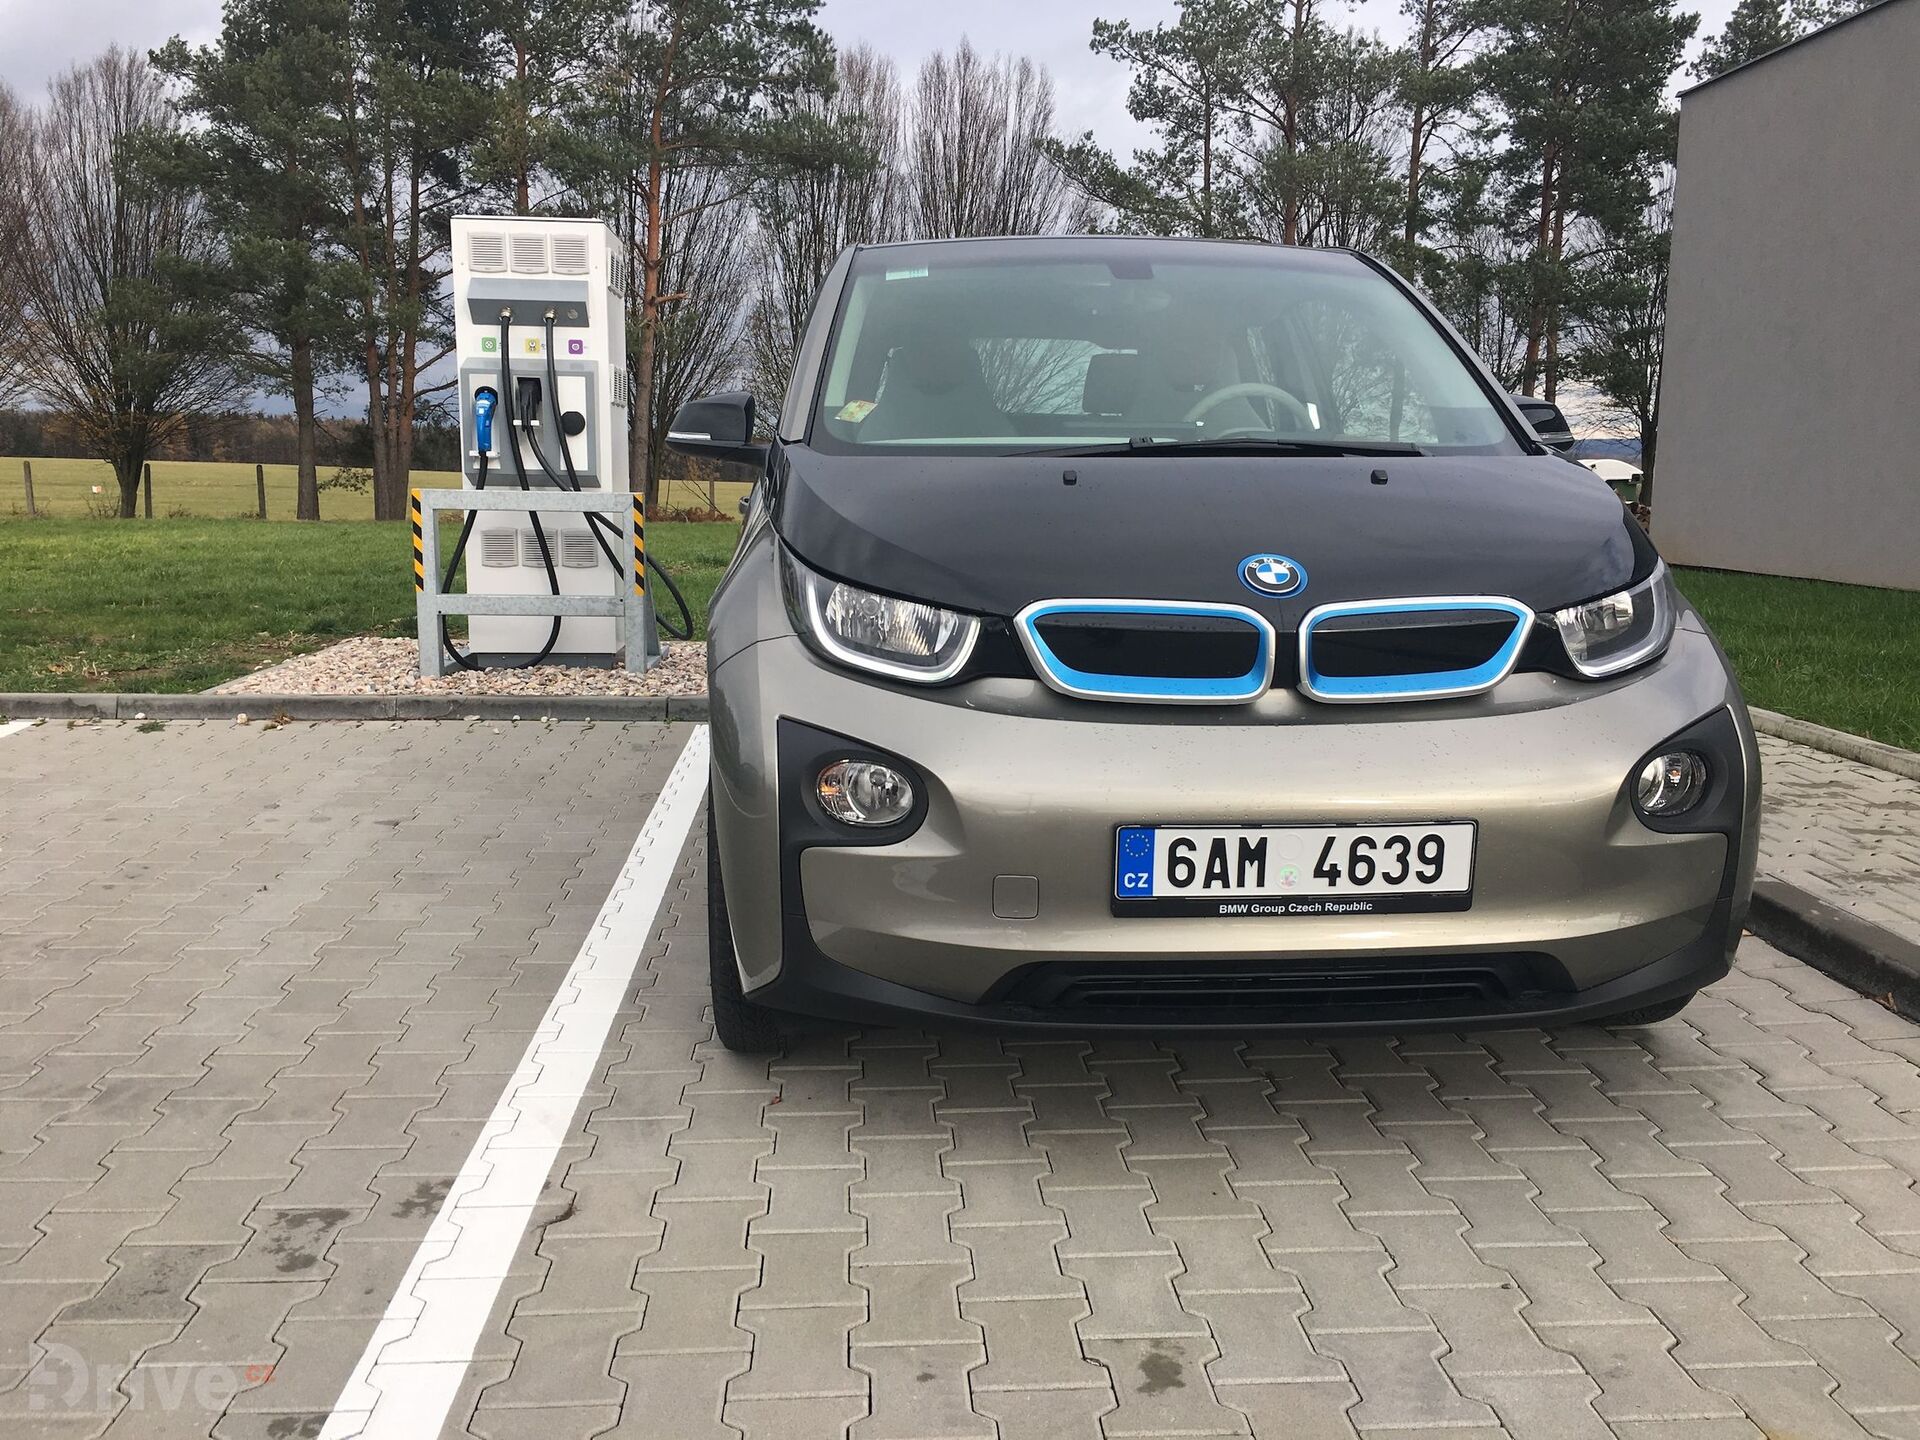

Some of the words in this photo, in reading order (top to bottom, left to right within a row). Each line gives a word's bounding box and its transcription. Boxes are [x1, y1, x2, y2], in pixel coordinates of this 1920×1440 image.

[1248, 558, 1292, 569] BMW
[1167, 836, 1267, 889] 6AM
[1313, 833, 1445, 887] 4639
[1124, 872, 1149, 889] CZ
[1219, 903, 1249, 914] BMW
[1252, 903, 1285, 915] Group
[1288, 902, 1323, 913] Czech
[1325, 901, 1373, 912] Republic
